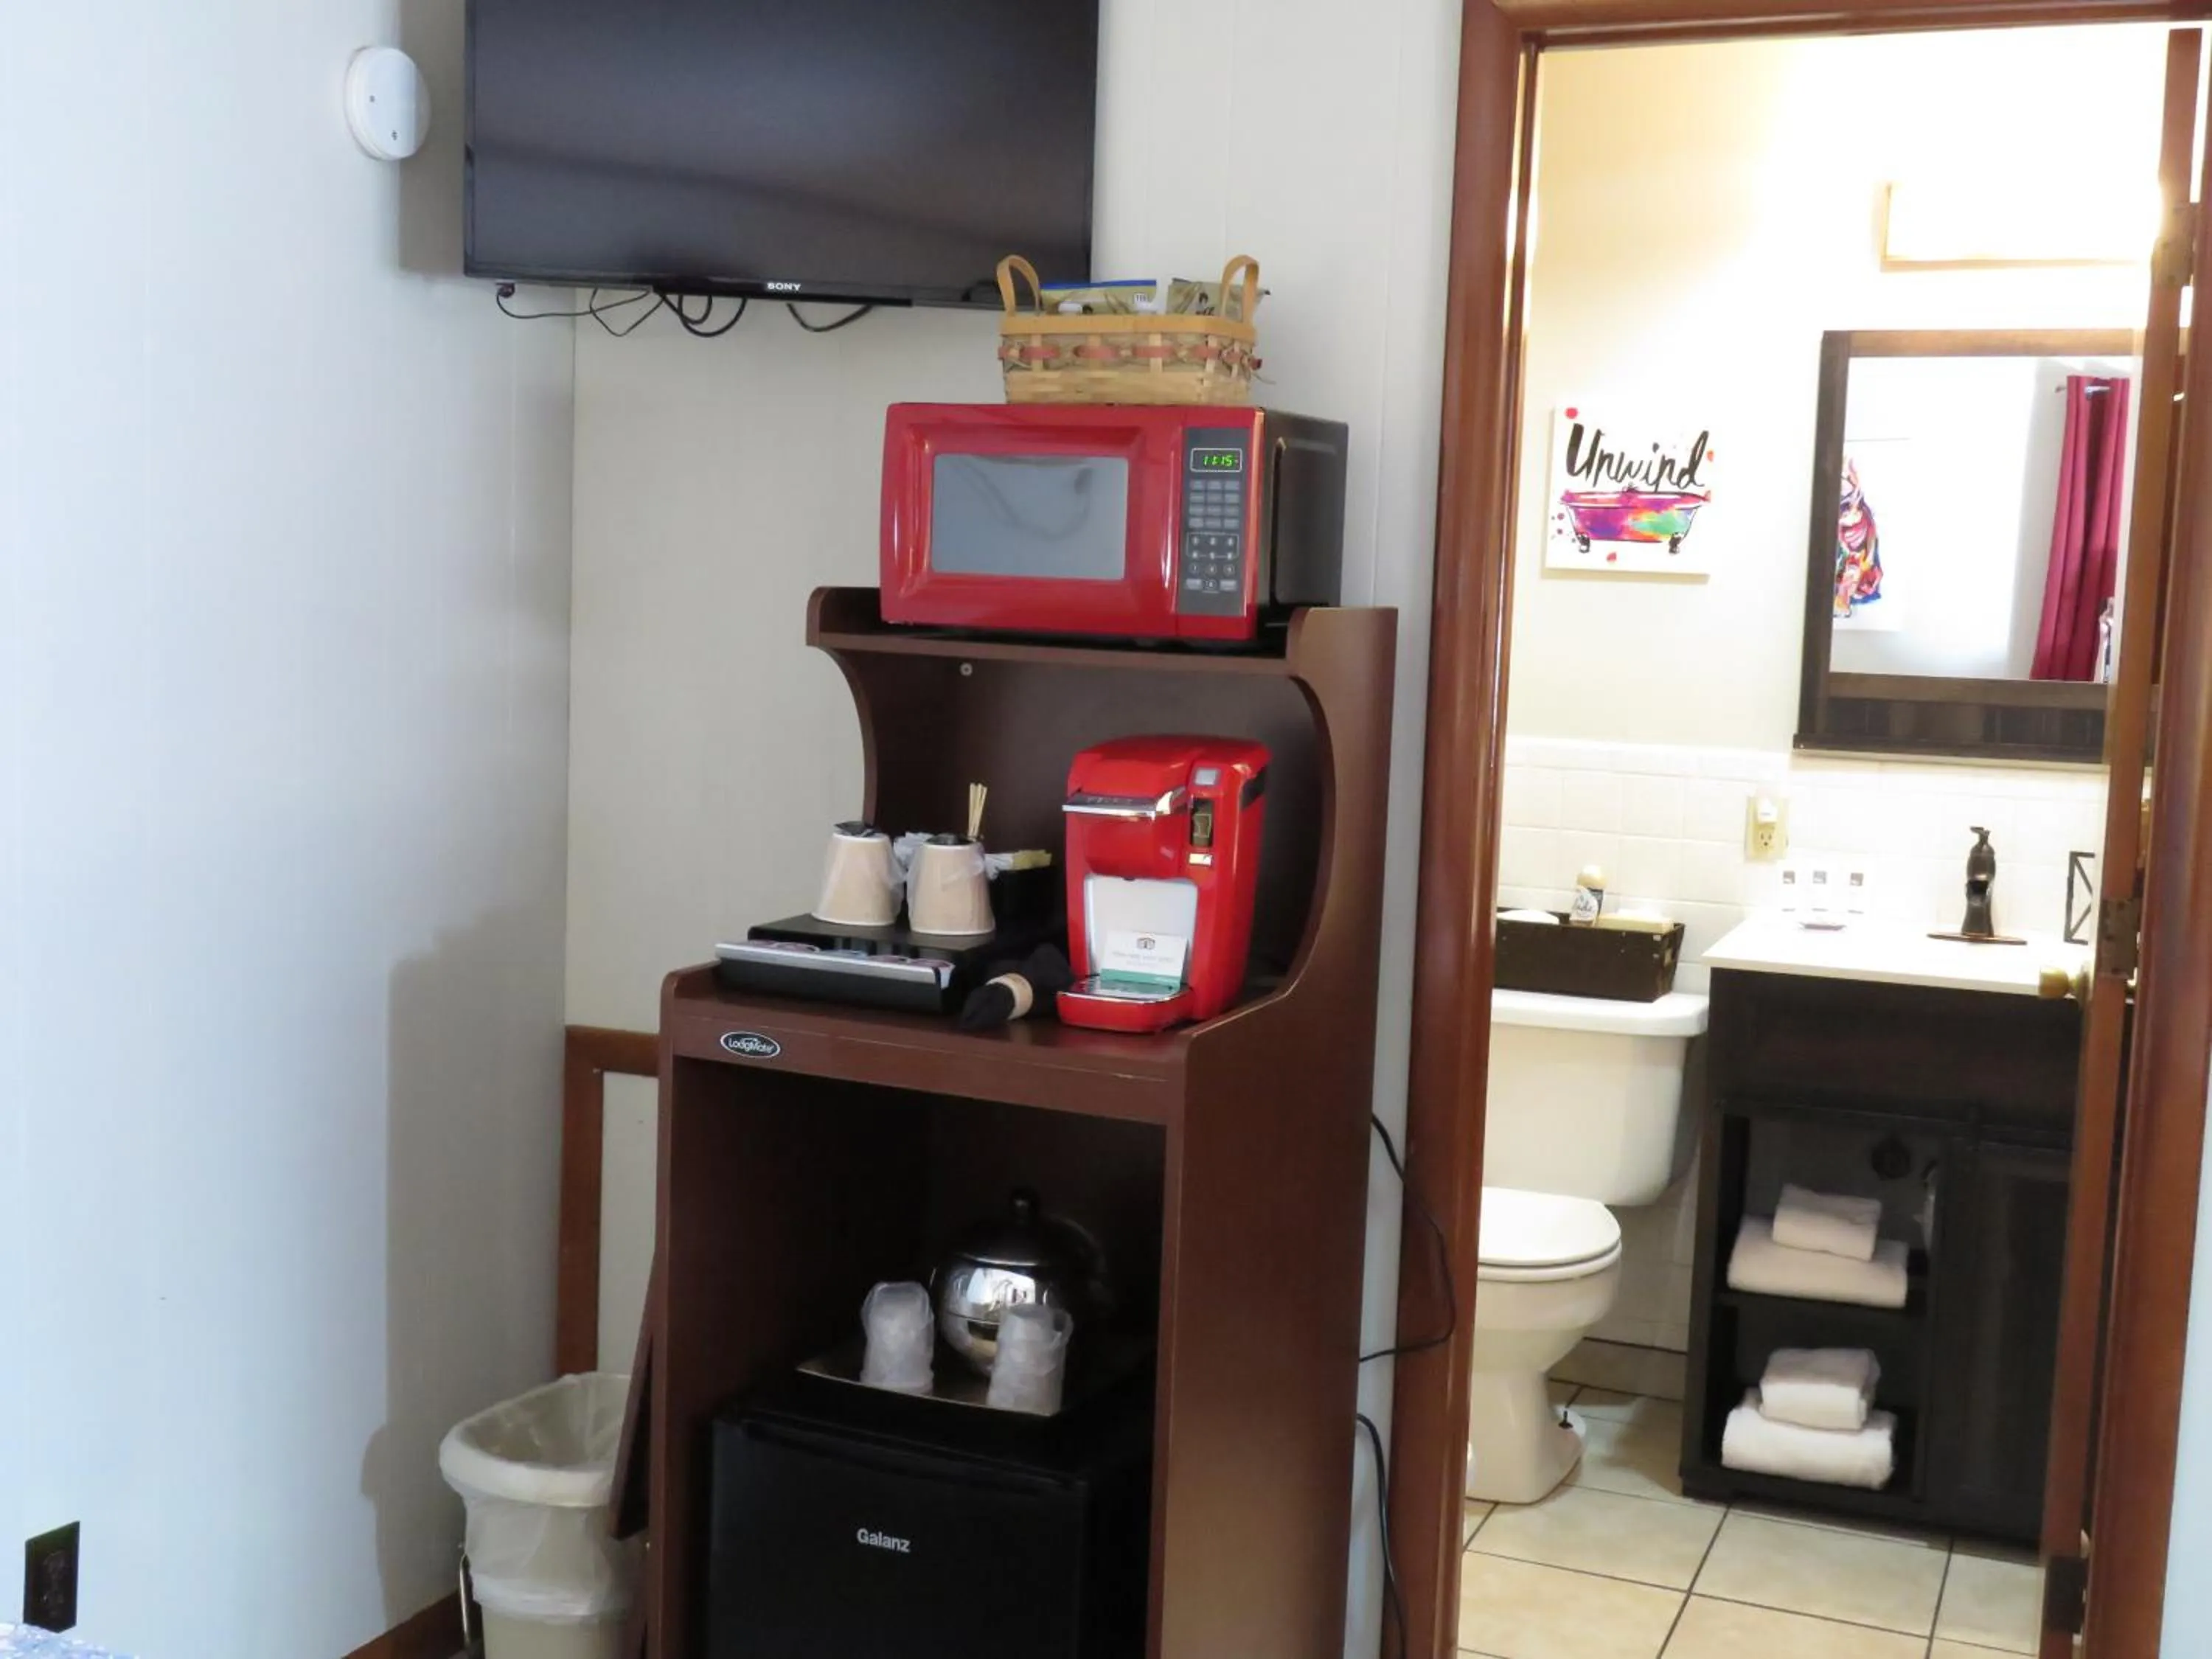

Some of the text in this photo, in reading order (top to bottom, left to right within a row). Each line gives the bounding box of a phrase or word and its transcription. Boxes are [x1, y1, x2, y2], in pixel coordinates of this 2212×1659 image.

[767, 282, 801, 292] SONY
[1566, 422, 1709, 493] Unwind
[857, 1528, 911, 1553] Galanz
